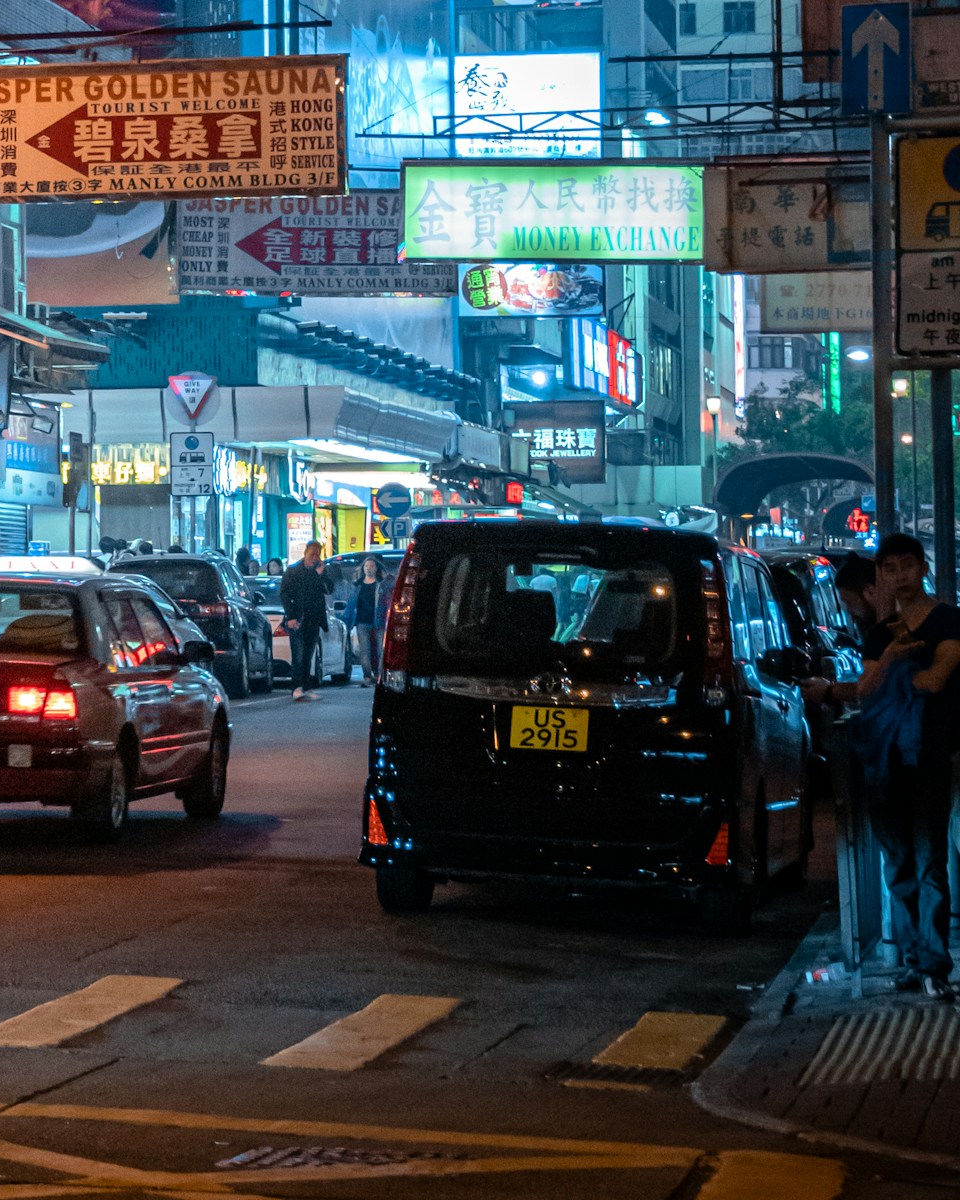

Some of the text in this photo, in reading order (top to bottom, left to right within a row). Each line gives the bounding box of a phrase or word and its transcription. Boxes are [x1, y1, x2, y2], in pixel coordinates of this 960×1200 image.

[84, 72, 211, 100] GOLDEN
[223, 68, 331, 96] SAUNA
[91, 98, 260, 114] TOURIST WELCOME
[291, 99, 333, 114] HONG
[291, 118, 334, 132] KONG
[73, 114, 258, 163] 碧泉桑拿
[291, 136, 335, 150] STYLE
[291, 154, 335, 169] SERVICE
[109, 177, 177, 191] MANLY
[184, 175, 242, 188] COMM
[250, 173, 301, 187] BLDG
[307, 172, 336, 185] 3/F
[517, 175, 698, 214] 人民幣找換
[410, 177, 507, 250] 金寶
[183, 216, 214, 228] MOST
[182, 231, 214, 243] CHEAP
[512, 226, 700, 252] MONEY EXCHANGE
[182, 246, 213, 258] MONEY
[182, 261, 213, 273] ONLY
[931, 256, 954, 267] am
[347, 278, 389, 288] COMM
[394, 278, 428, 288] BLDG
[550, 449, 597, 457] JEWELLERY
[198, 468, 205, 477] 7
[199, 484, 210, 494] 12
[534, 709, 566, 728] US
[520, 728, 578, 748] 2915
